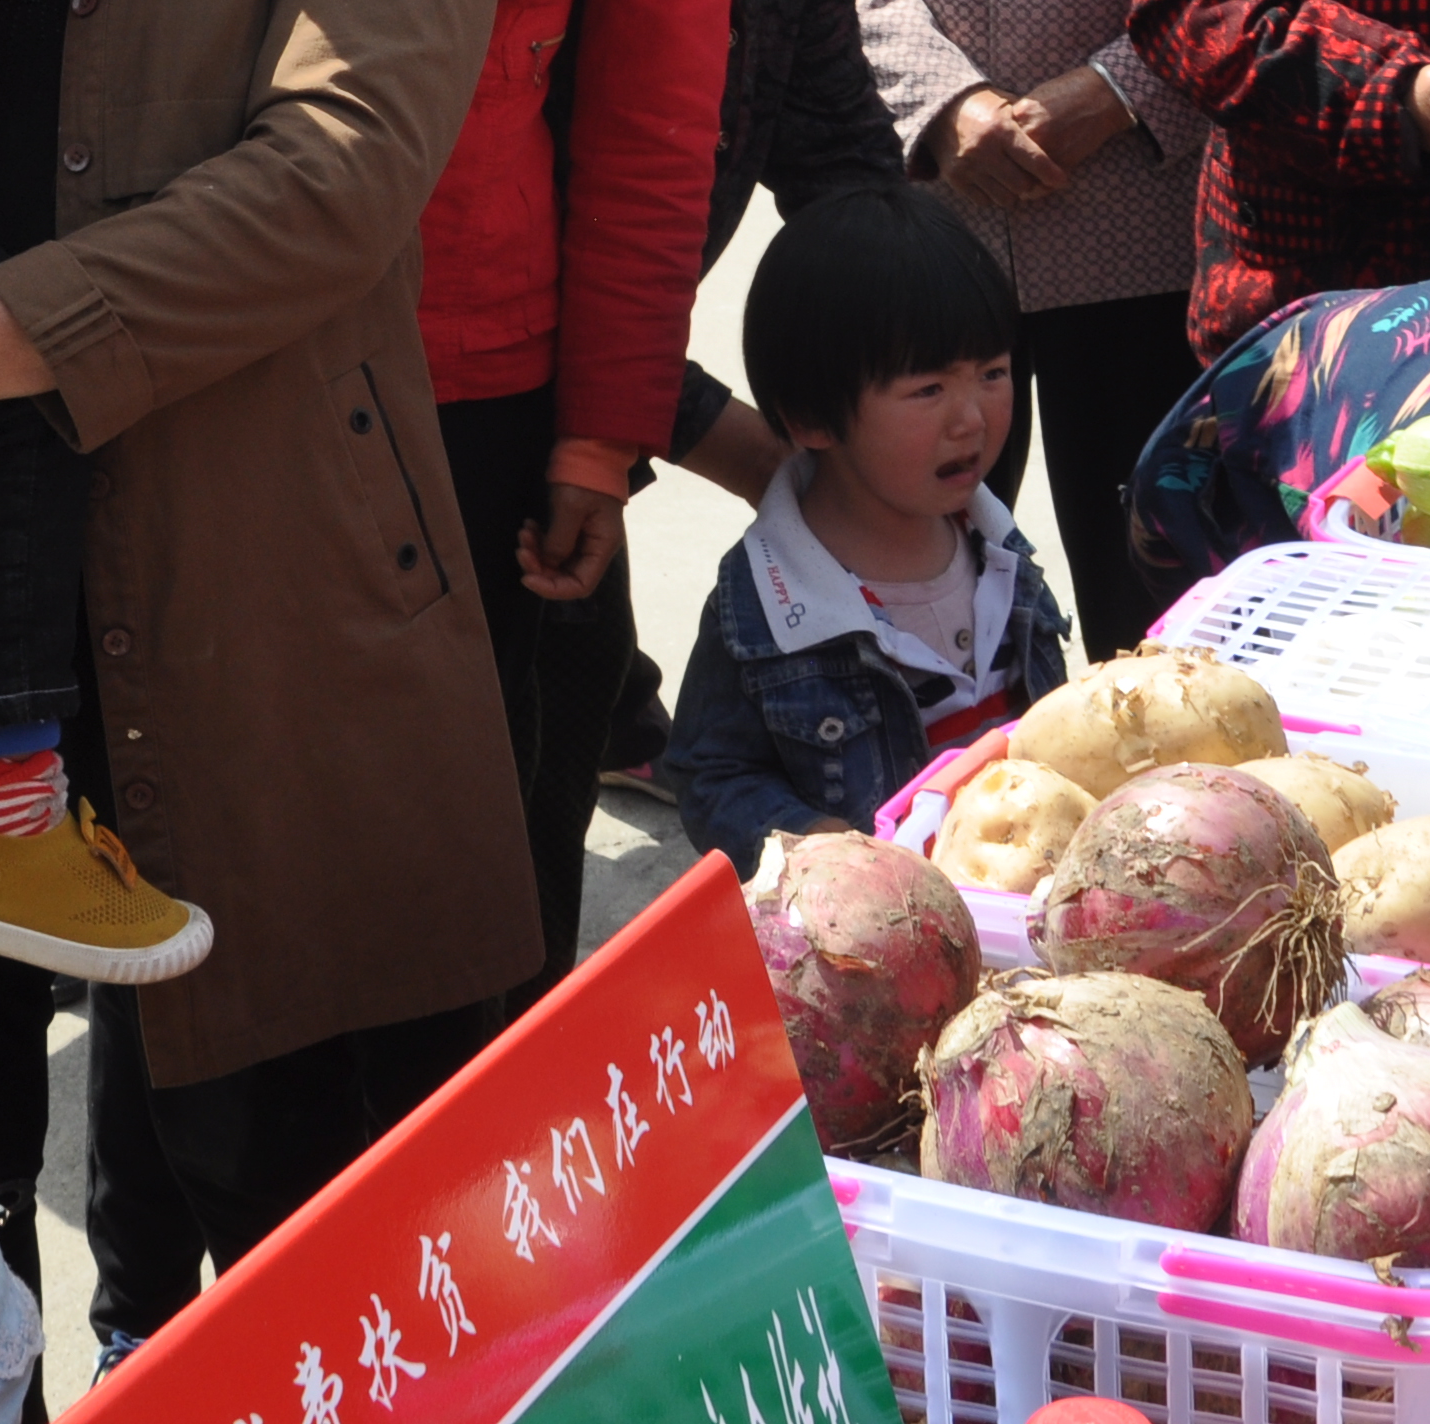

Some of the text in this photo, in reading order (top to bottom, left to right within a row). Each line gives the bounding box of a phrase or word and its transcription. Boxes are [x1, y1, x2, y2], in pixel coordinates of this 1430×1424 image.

[767, 565, 791, 605] HAPPY
[232, 1231, 477, 1424] 费扶贫
[502, 987, 737, 1264] 我们在行动
